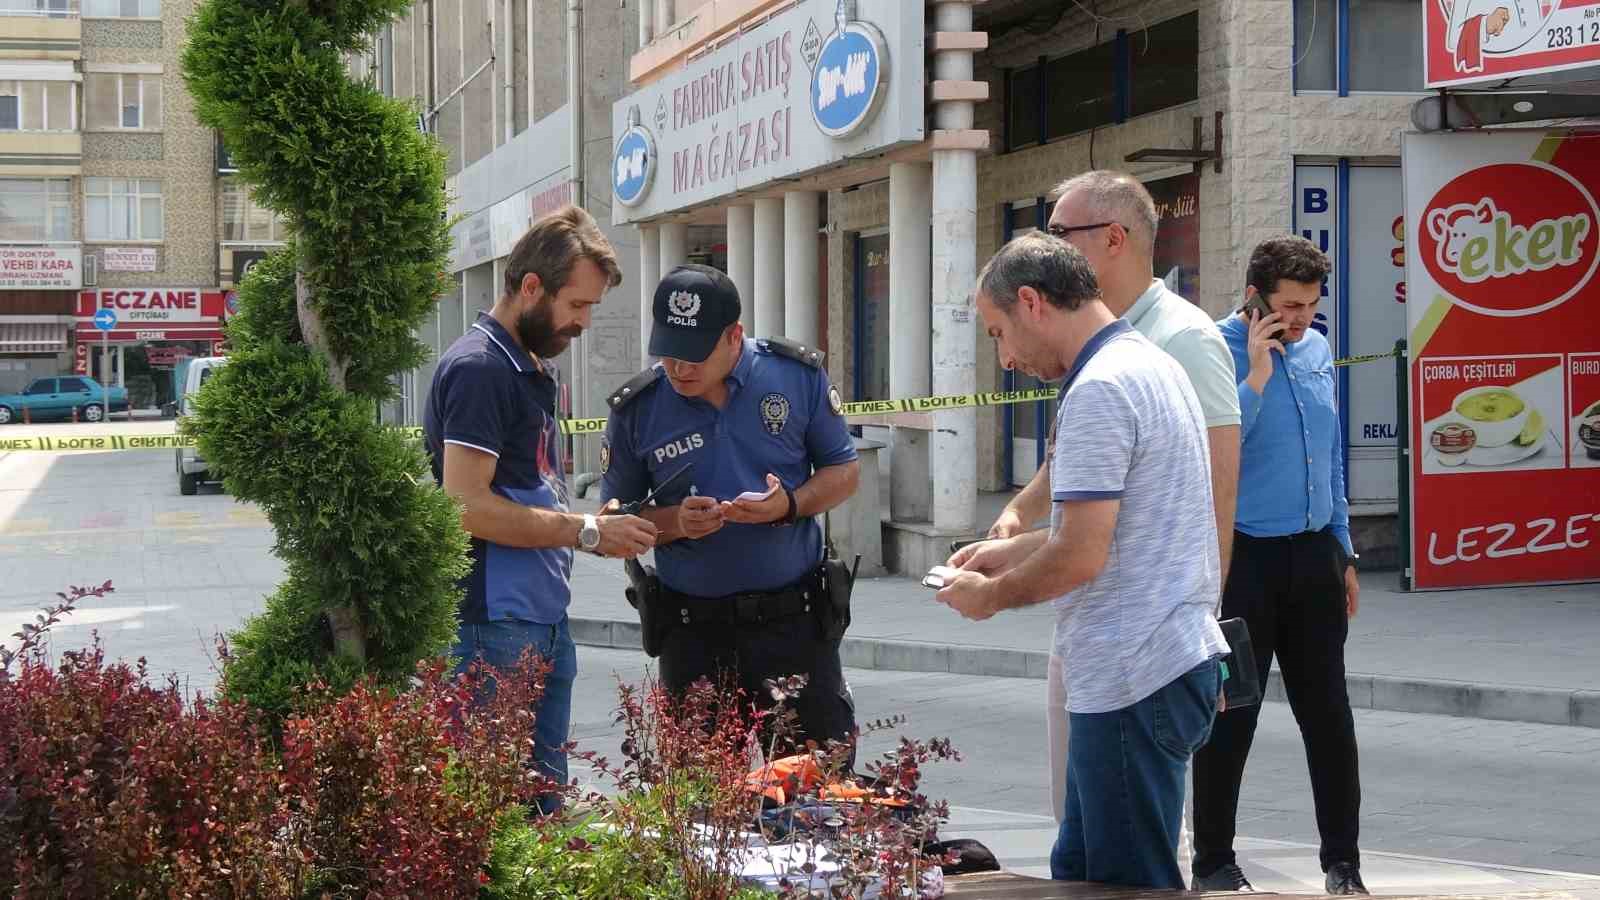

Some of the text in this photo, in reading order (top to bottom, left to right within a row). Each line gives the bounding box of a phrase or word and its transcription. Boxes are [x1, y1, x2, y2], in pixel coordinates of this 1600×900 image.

[1548, 25, 1573, 48] 233
[1577, 24, 1584, 43] 1
[673, 61, 736, 130] FABRİKA
[741, 31, 792, 101] SATIŞ
[673, 106, 792, 194] MAĞAZASI
[1460, 216, 1586, 277] eker
[41, 259, 73, 270] KARA
[102, 291, 196, 309] ECZANE
[667, 315, 697, 327] POLİS
[1424, 361, 1517, 382] ÇORBA ÇEŞİTLERİ
[654, 433, 704, 463] POLİS
